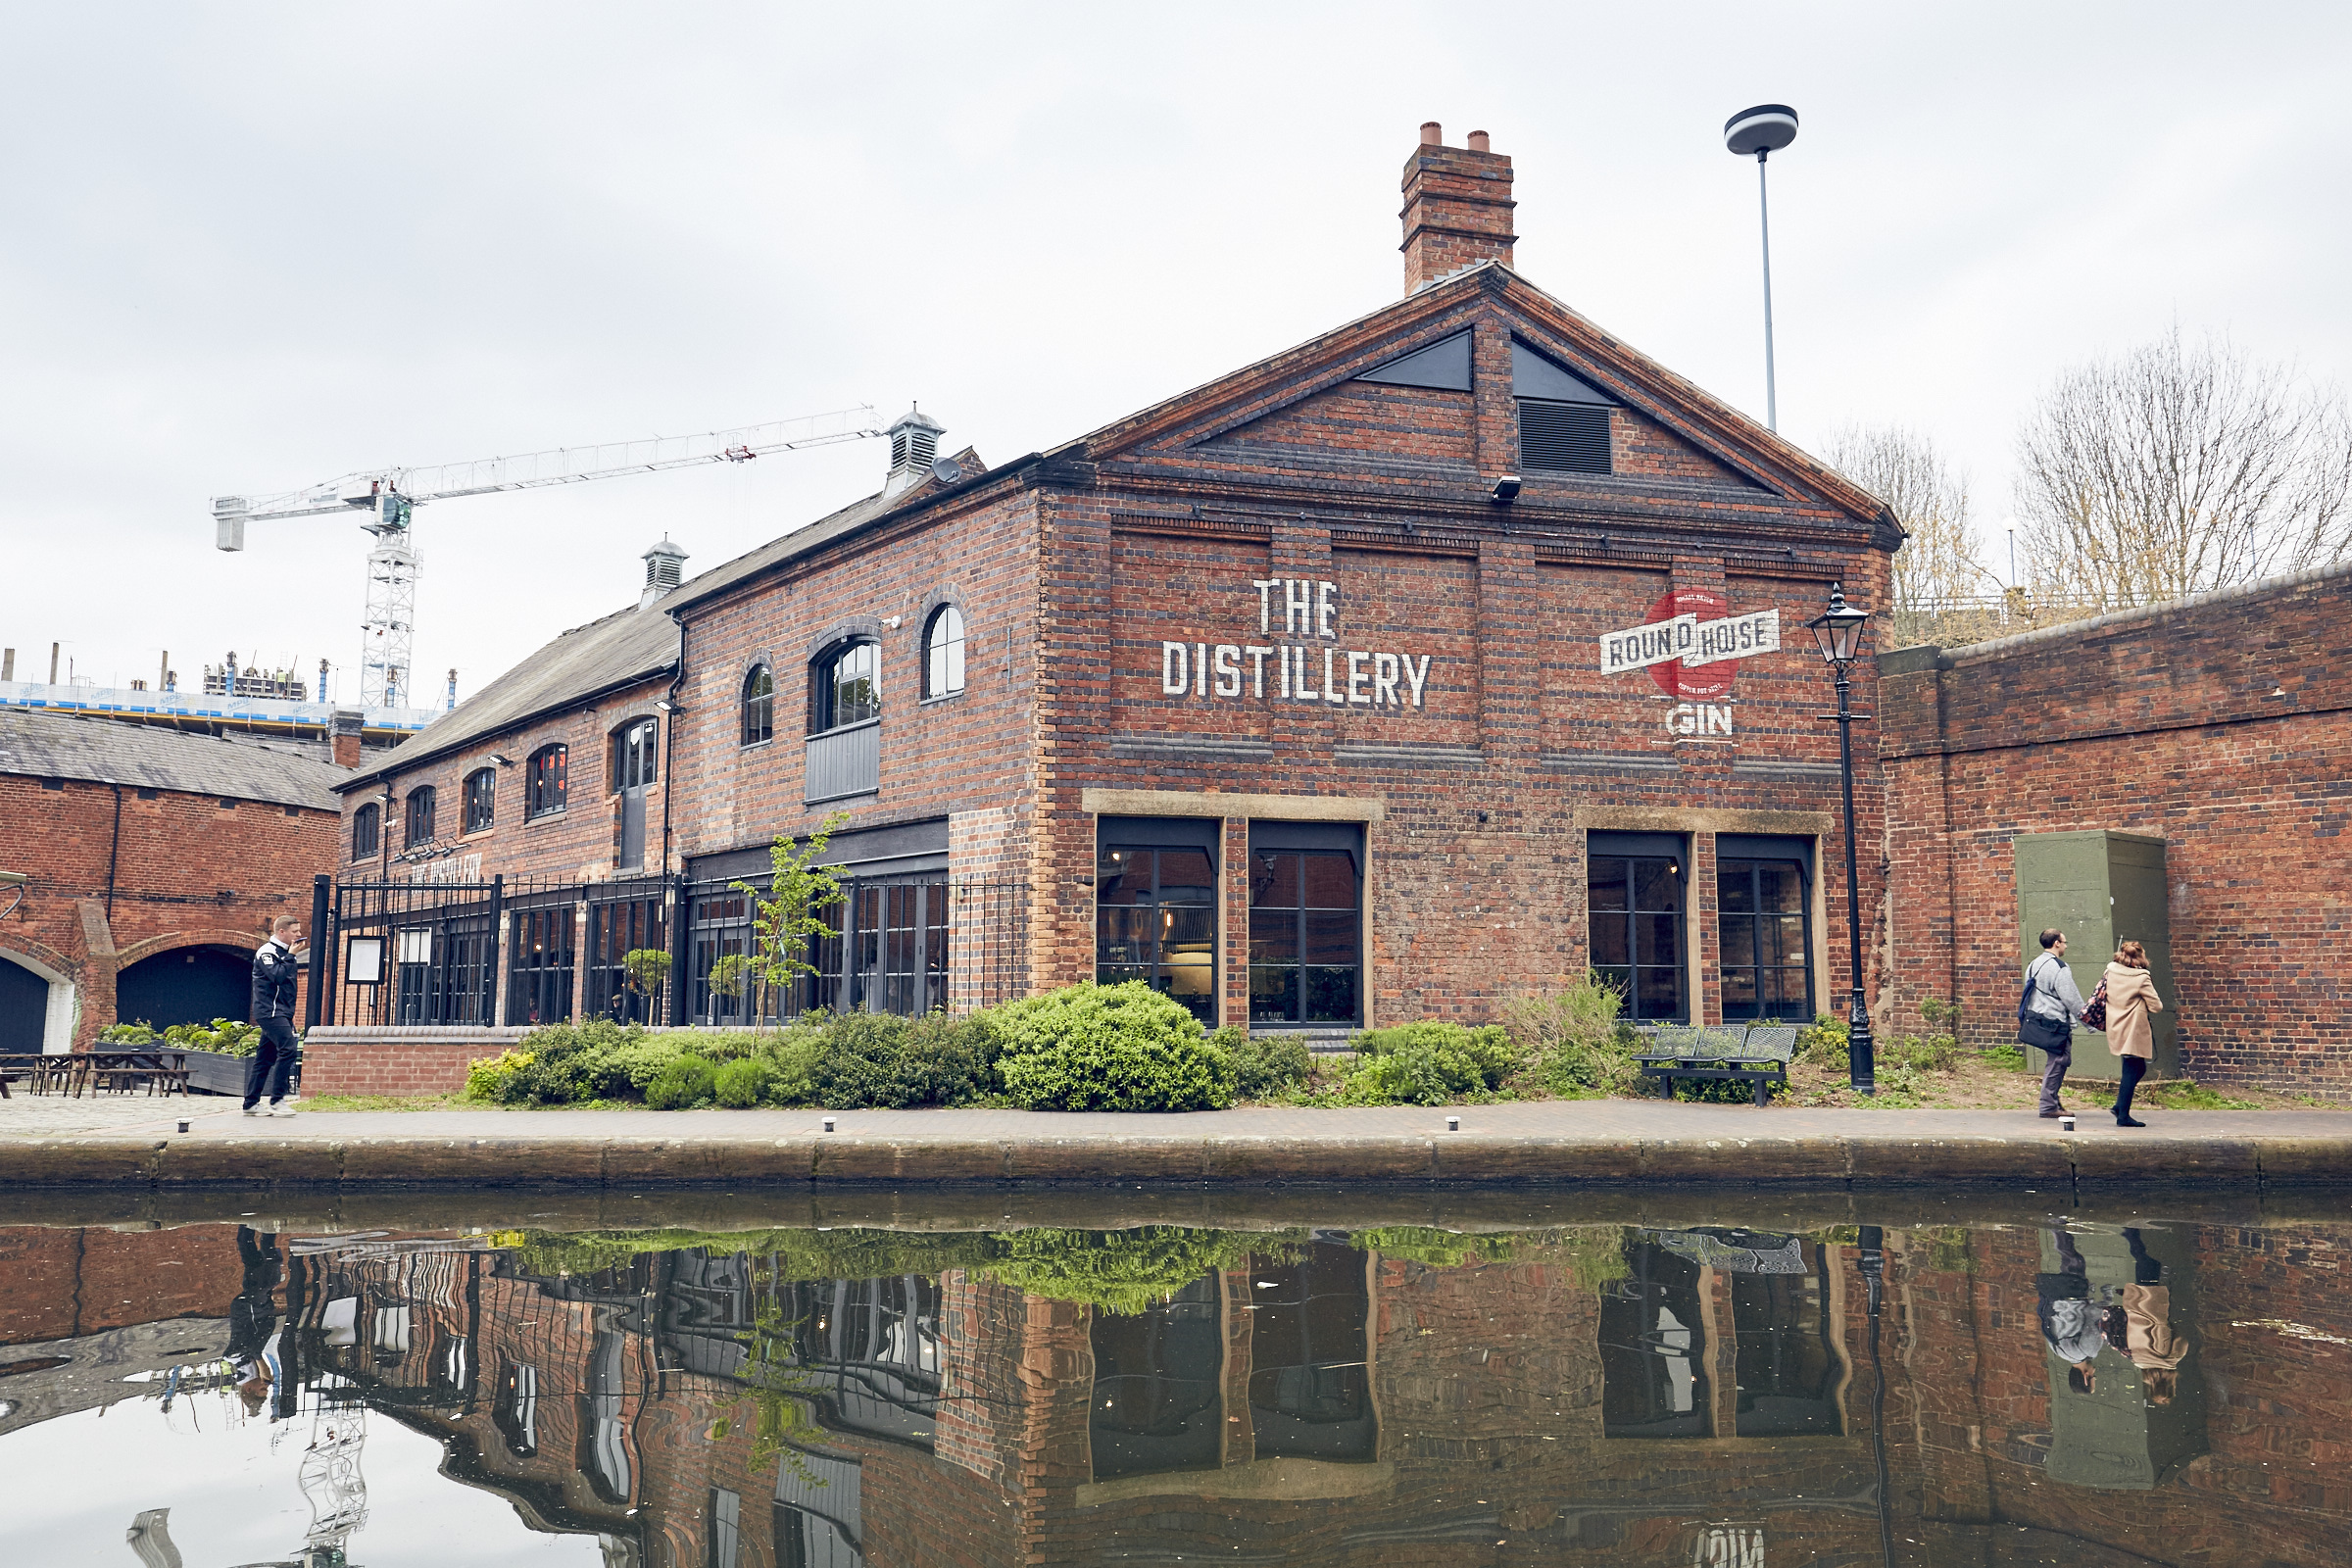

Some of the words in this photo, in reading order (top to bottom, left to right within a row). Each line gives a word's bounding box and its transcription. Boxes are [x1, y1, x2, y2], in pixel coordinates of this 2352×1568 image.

[1252, 578, 1337, 640] THE
[1609, 622, 1691, 667] ROUND
[1162, 640, 1432, 708] DISTILLERY
[1666, 703, 1733, 736] GIN
